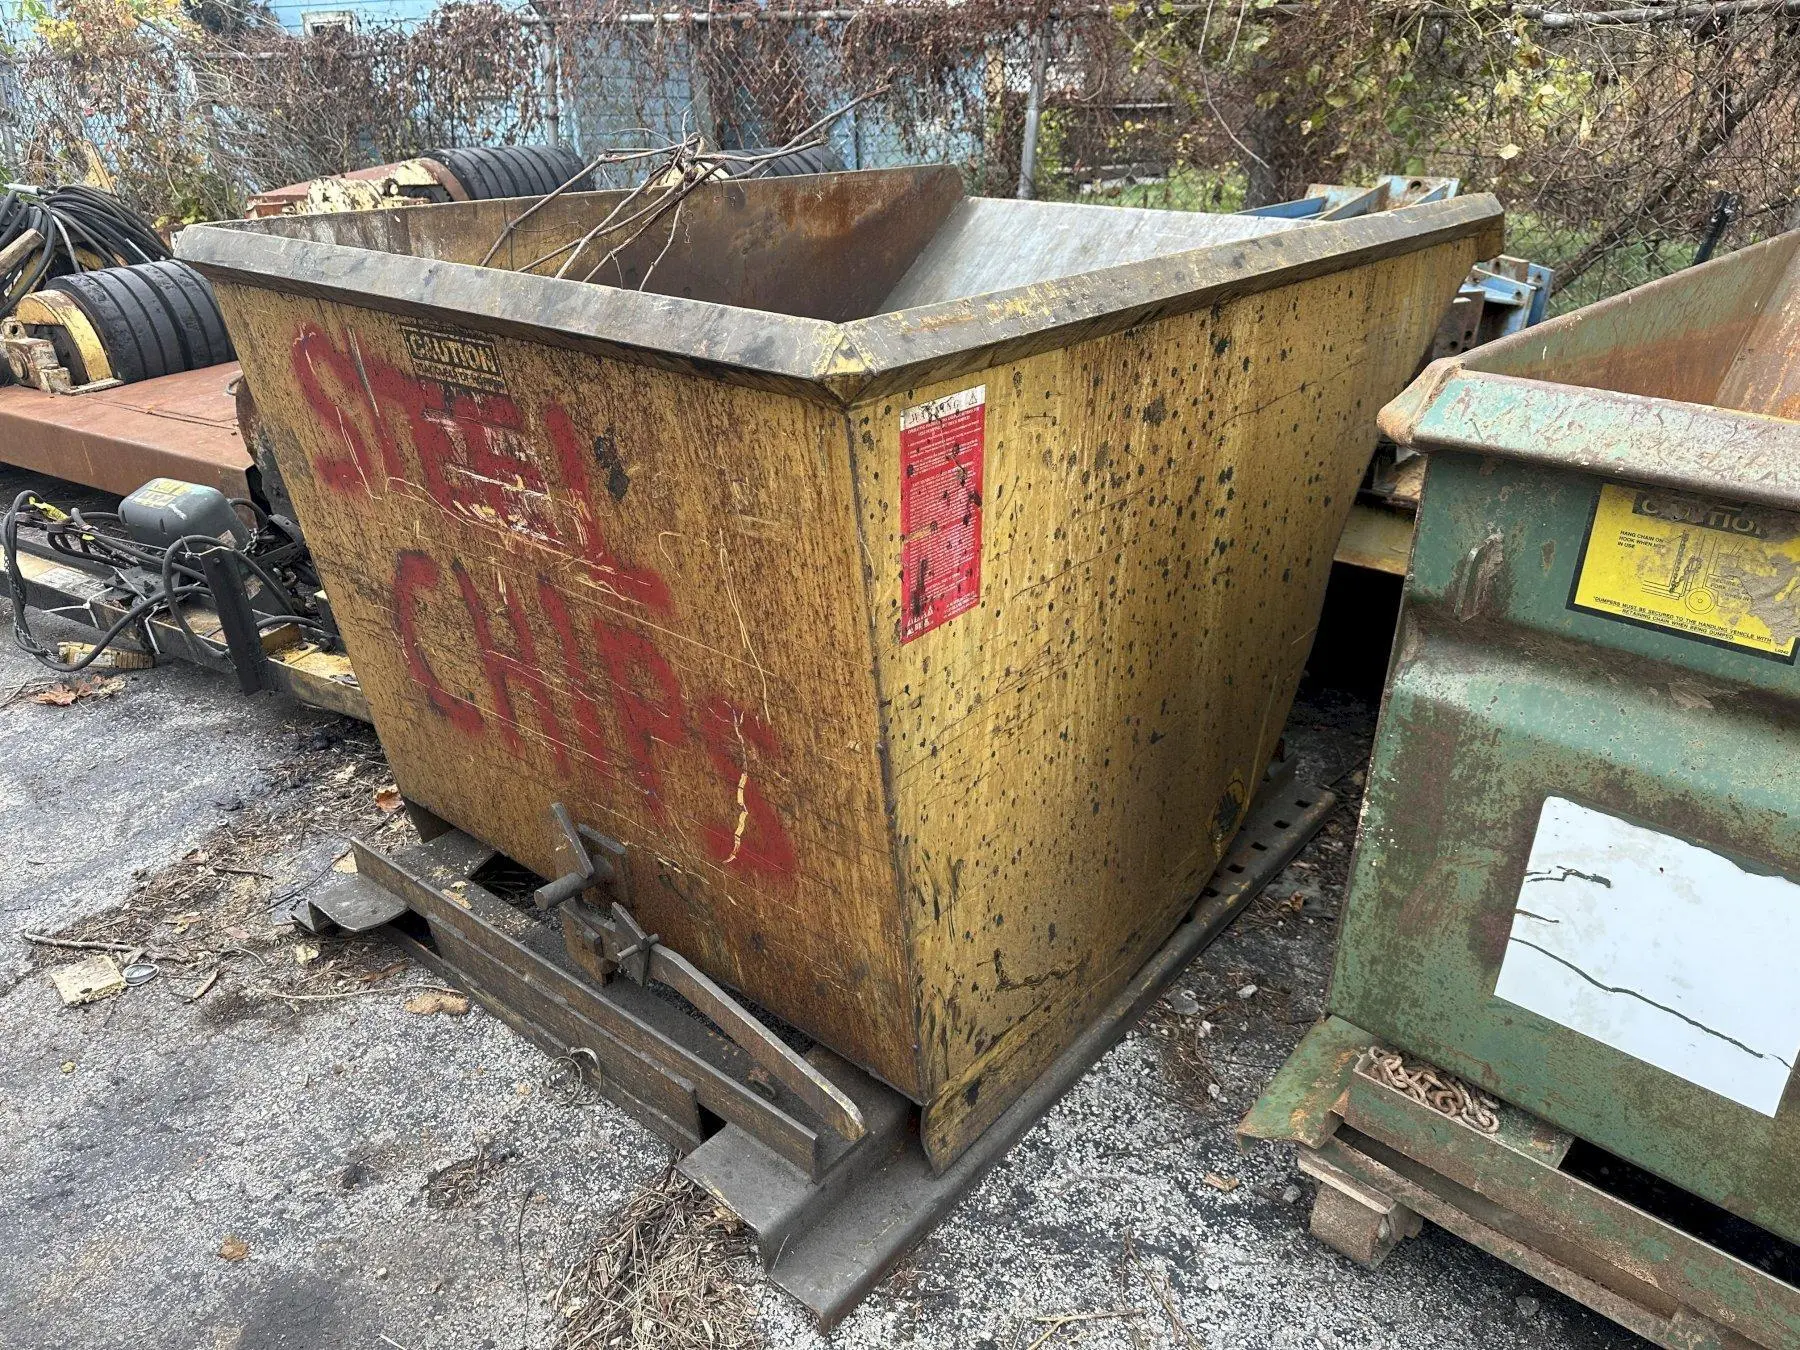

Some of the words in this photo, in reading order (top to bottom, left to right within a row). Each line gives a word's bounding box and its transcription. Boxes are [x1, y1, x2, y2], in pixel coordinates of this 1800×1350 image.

[409, 331, 497, 374] CAUTION
[1620, 530, 1636, 538] HANG
[1637, 533, 1655, 542] CHAIN
[1641, 498, 1768, 536] CTIO
[1622, 603, 1637, 611] MUST
[1700, 621, 1728, 632] HANDLING
[1730, 629, 1755, 639] VEHICLE
[1757, 635, 1772, 643] WITH
